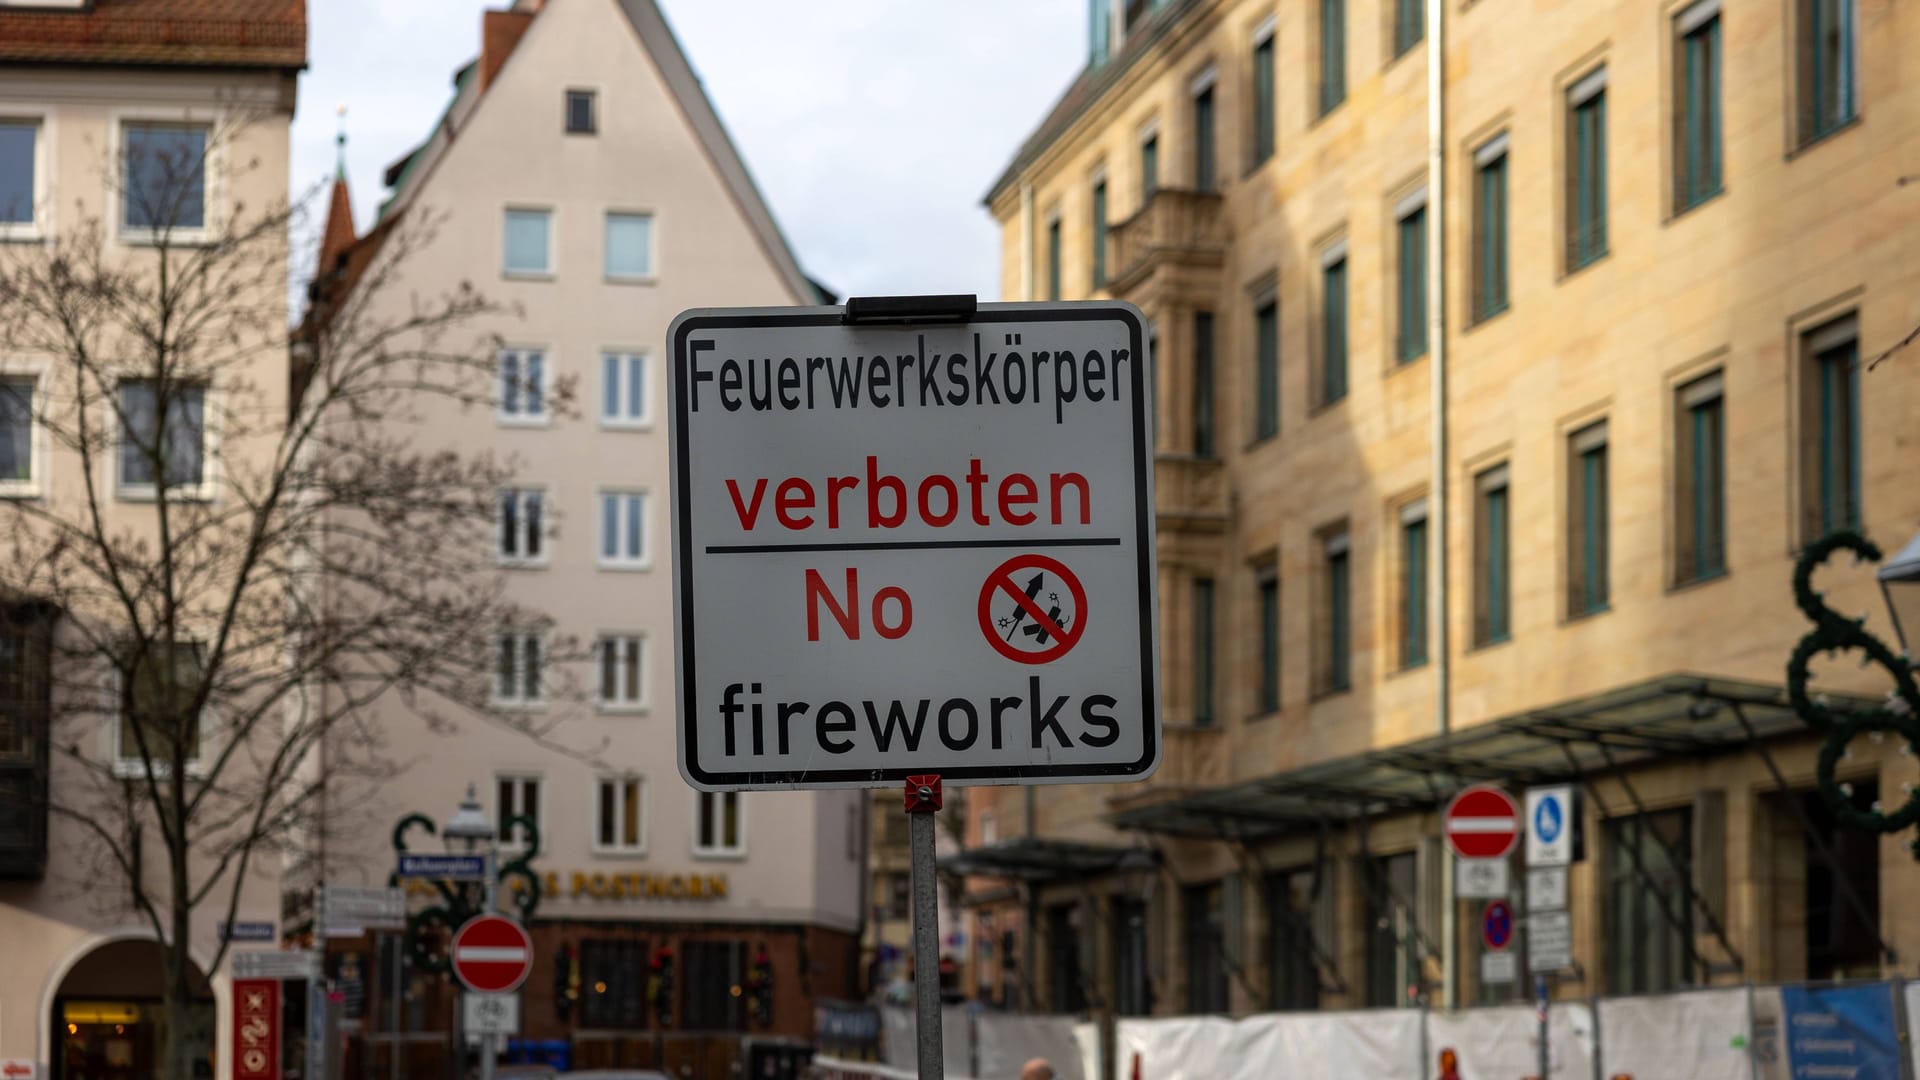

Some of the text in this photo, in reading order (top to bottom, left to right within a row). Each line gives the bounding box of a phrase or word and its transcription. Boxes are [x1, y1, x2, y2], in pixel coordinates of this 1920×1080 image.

[689, 333, 1130, 424] Feuerwerkskörper
[725, 455, 1091, 531] verboten
[805, 567, 913, 642] No
[718, 675, 1121, 757] fireworks
